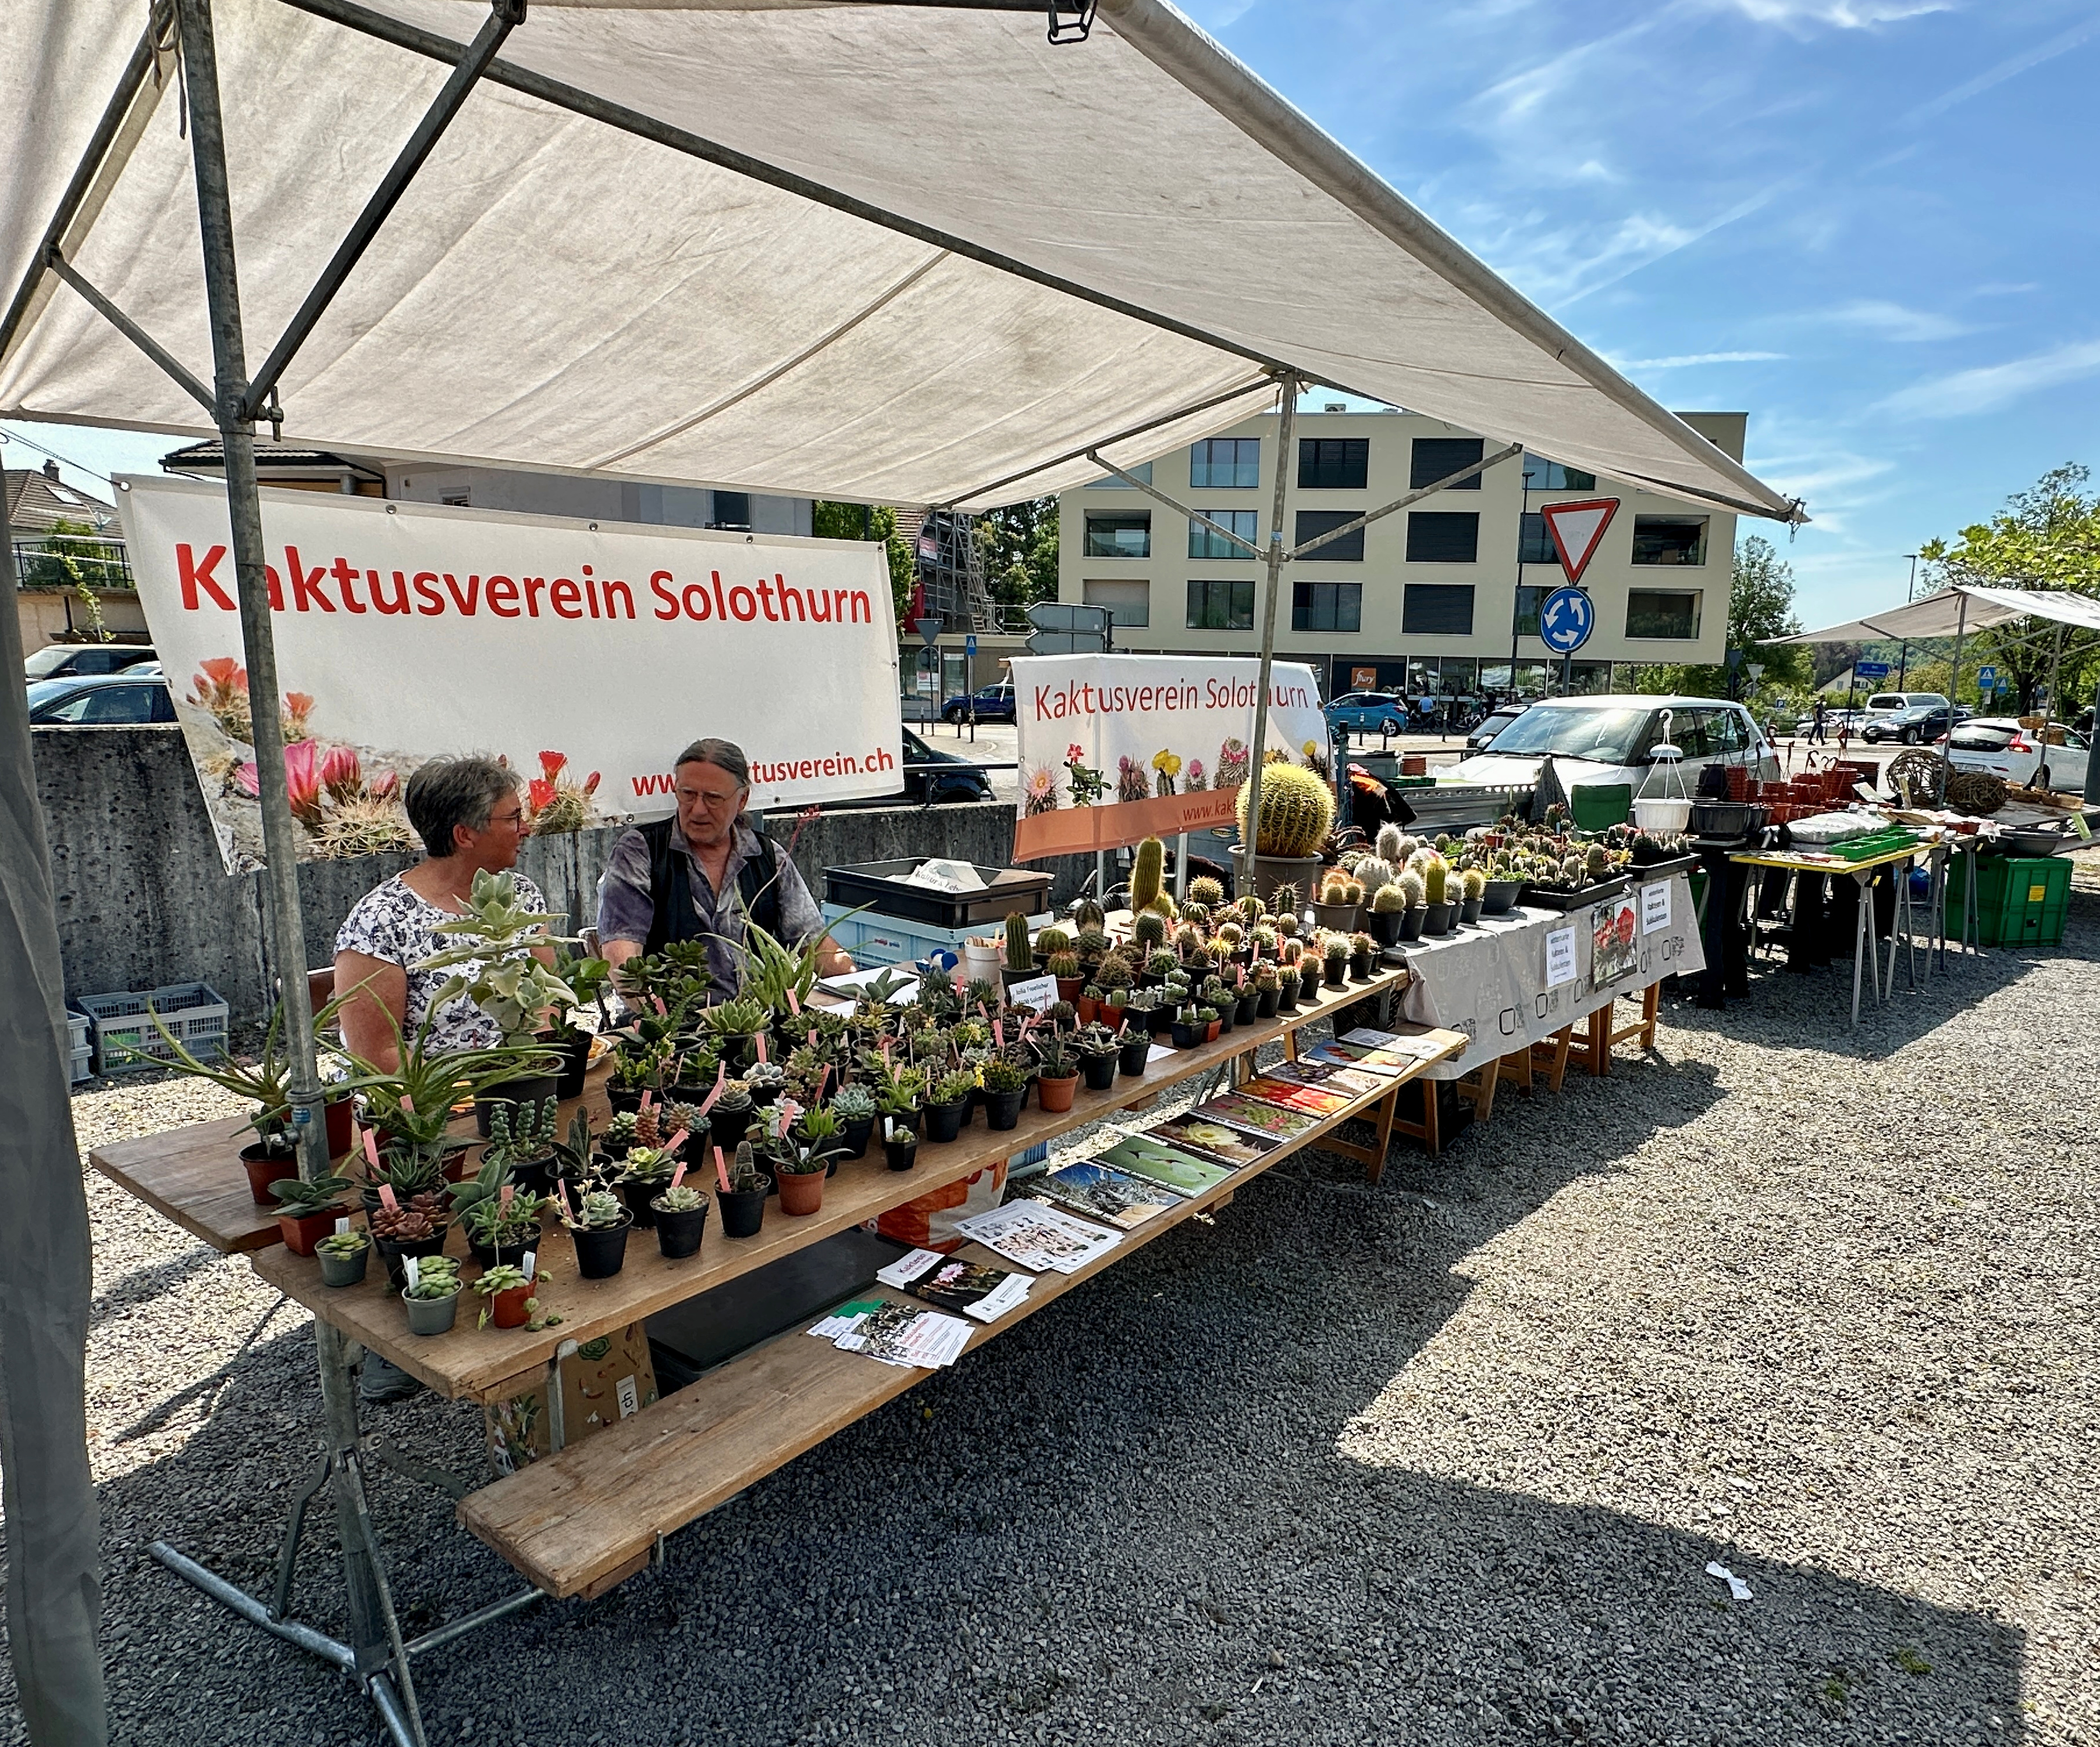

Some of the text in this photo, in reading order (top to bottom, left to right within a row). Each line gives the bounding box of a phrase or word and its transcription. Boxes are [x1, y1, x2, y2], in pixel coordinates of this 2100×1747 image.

[650, 570, 871, 623] Solothurn
[1035, 676, 1309, 721] Kaktusverein Soloturn
